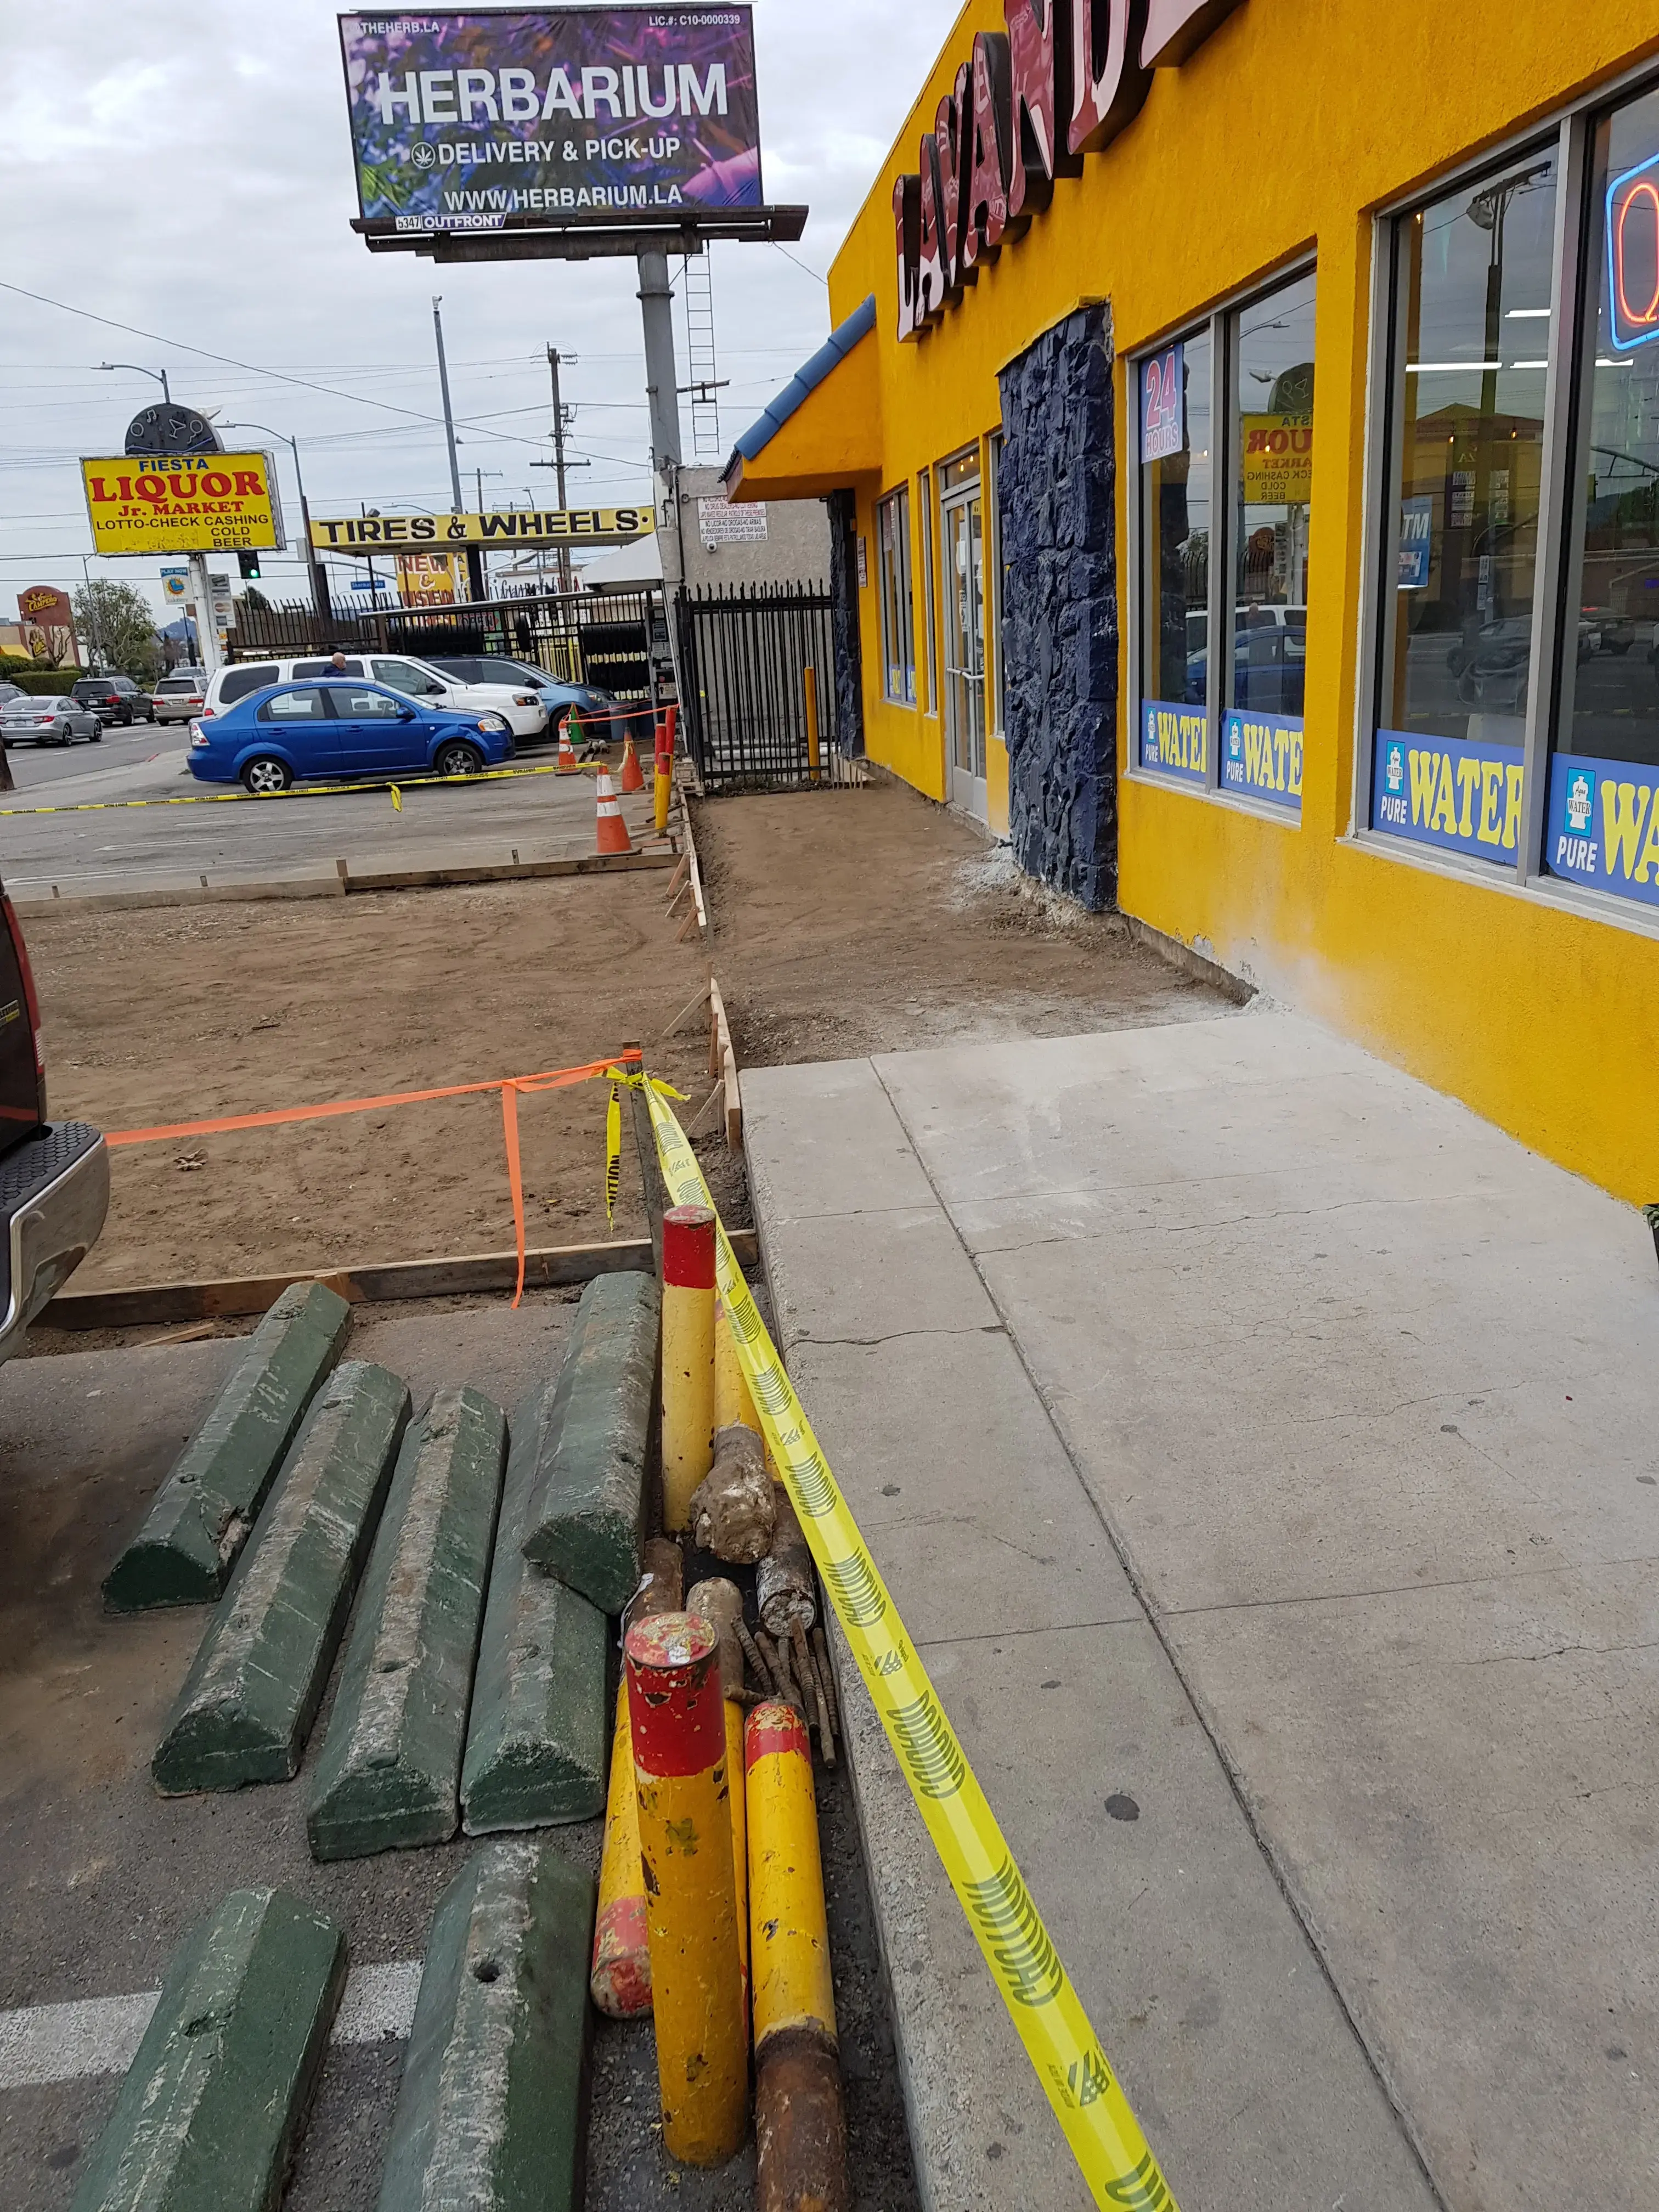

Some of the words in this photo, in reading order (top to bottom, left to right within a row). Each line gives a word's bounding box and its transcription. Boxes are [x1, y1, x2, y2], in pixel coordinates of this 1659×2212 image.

[679, 14, 740, 26] C10-0000339
[377, 63, 728, 125] HERBARIUM
[438, 141, 555, 165] DELIVERY
[562, 140, 579, 161] &
[585, 137, 680, 160] PICK-UP
[444, 184, 683, 211] WWWHERBARIUM.LA
[398, 216, 420, 228] 5347
[424, 215, 502, 228] OUTFRONT
[1146, 351, 1177, 430] 24
[1145, 422, 1179, 458] HOURS
[139, 458, 209, 472] FIESTA
[89, 471, 266, 504] LIQUOR
[118, 505, 146, 517] Jr.
[152, 501, 244, 515] MARKET
[96, 516, 200, 530] LOTTO-CHECK
[204, 514, 269, 526] CASHING
[211, 526, 250, 537] COLD
[319, 517, 436, 543] TIRES
[447, 516, 468, 539] &
[1400, 512, 1430, 540] TM
[213, 537, 253, 548] BEER
[396, 555, 447, 574] NEW
[419, 573, 436, 590] &
[1145, 744, 1158, 763] PURE
[1226, 760, 1244, 783] PURE
[1387, 766, 1402, 778] WATER
[1380, 795, 1408, 825] PURE
[1568, 799, 1590, 815] WATER
[1556, 836, 1598, 873] PURE
